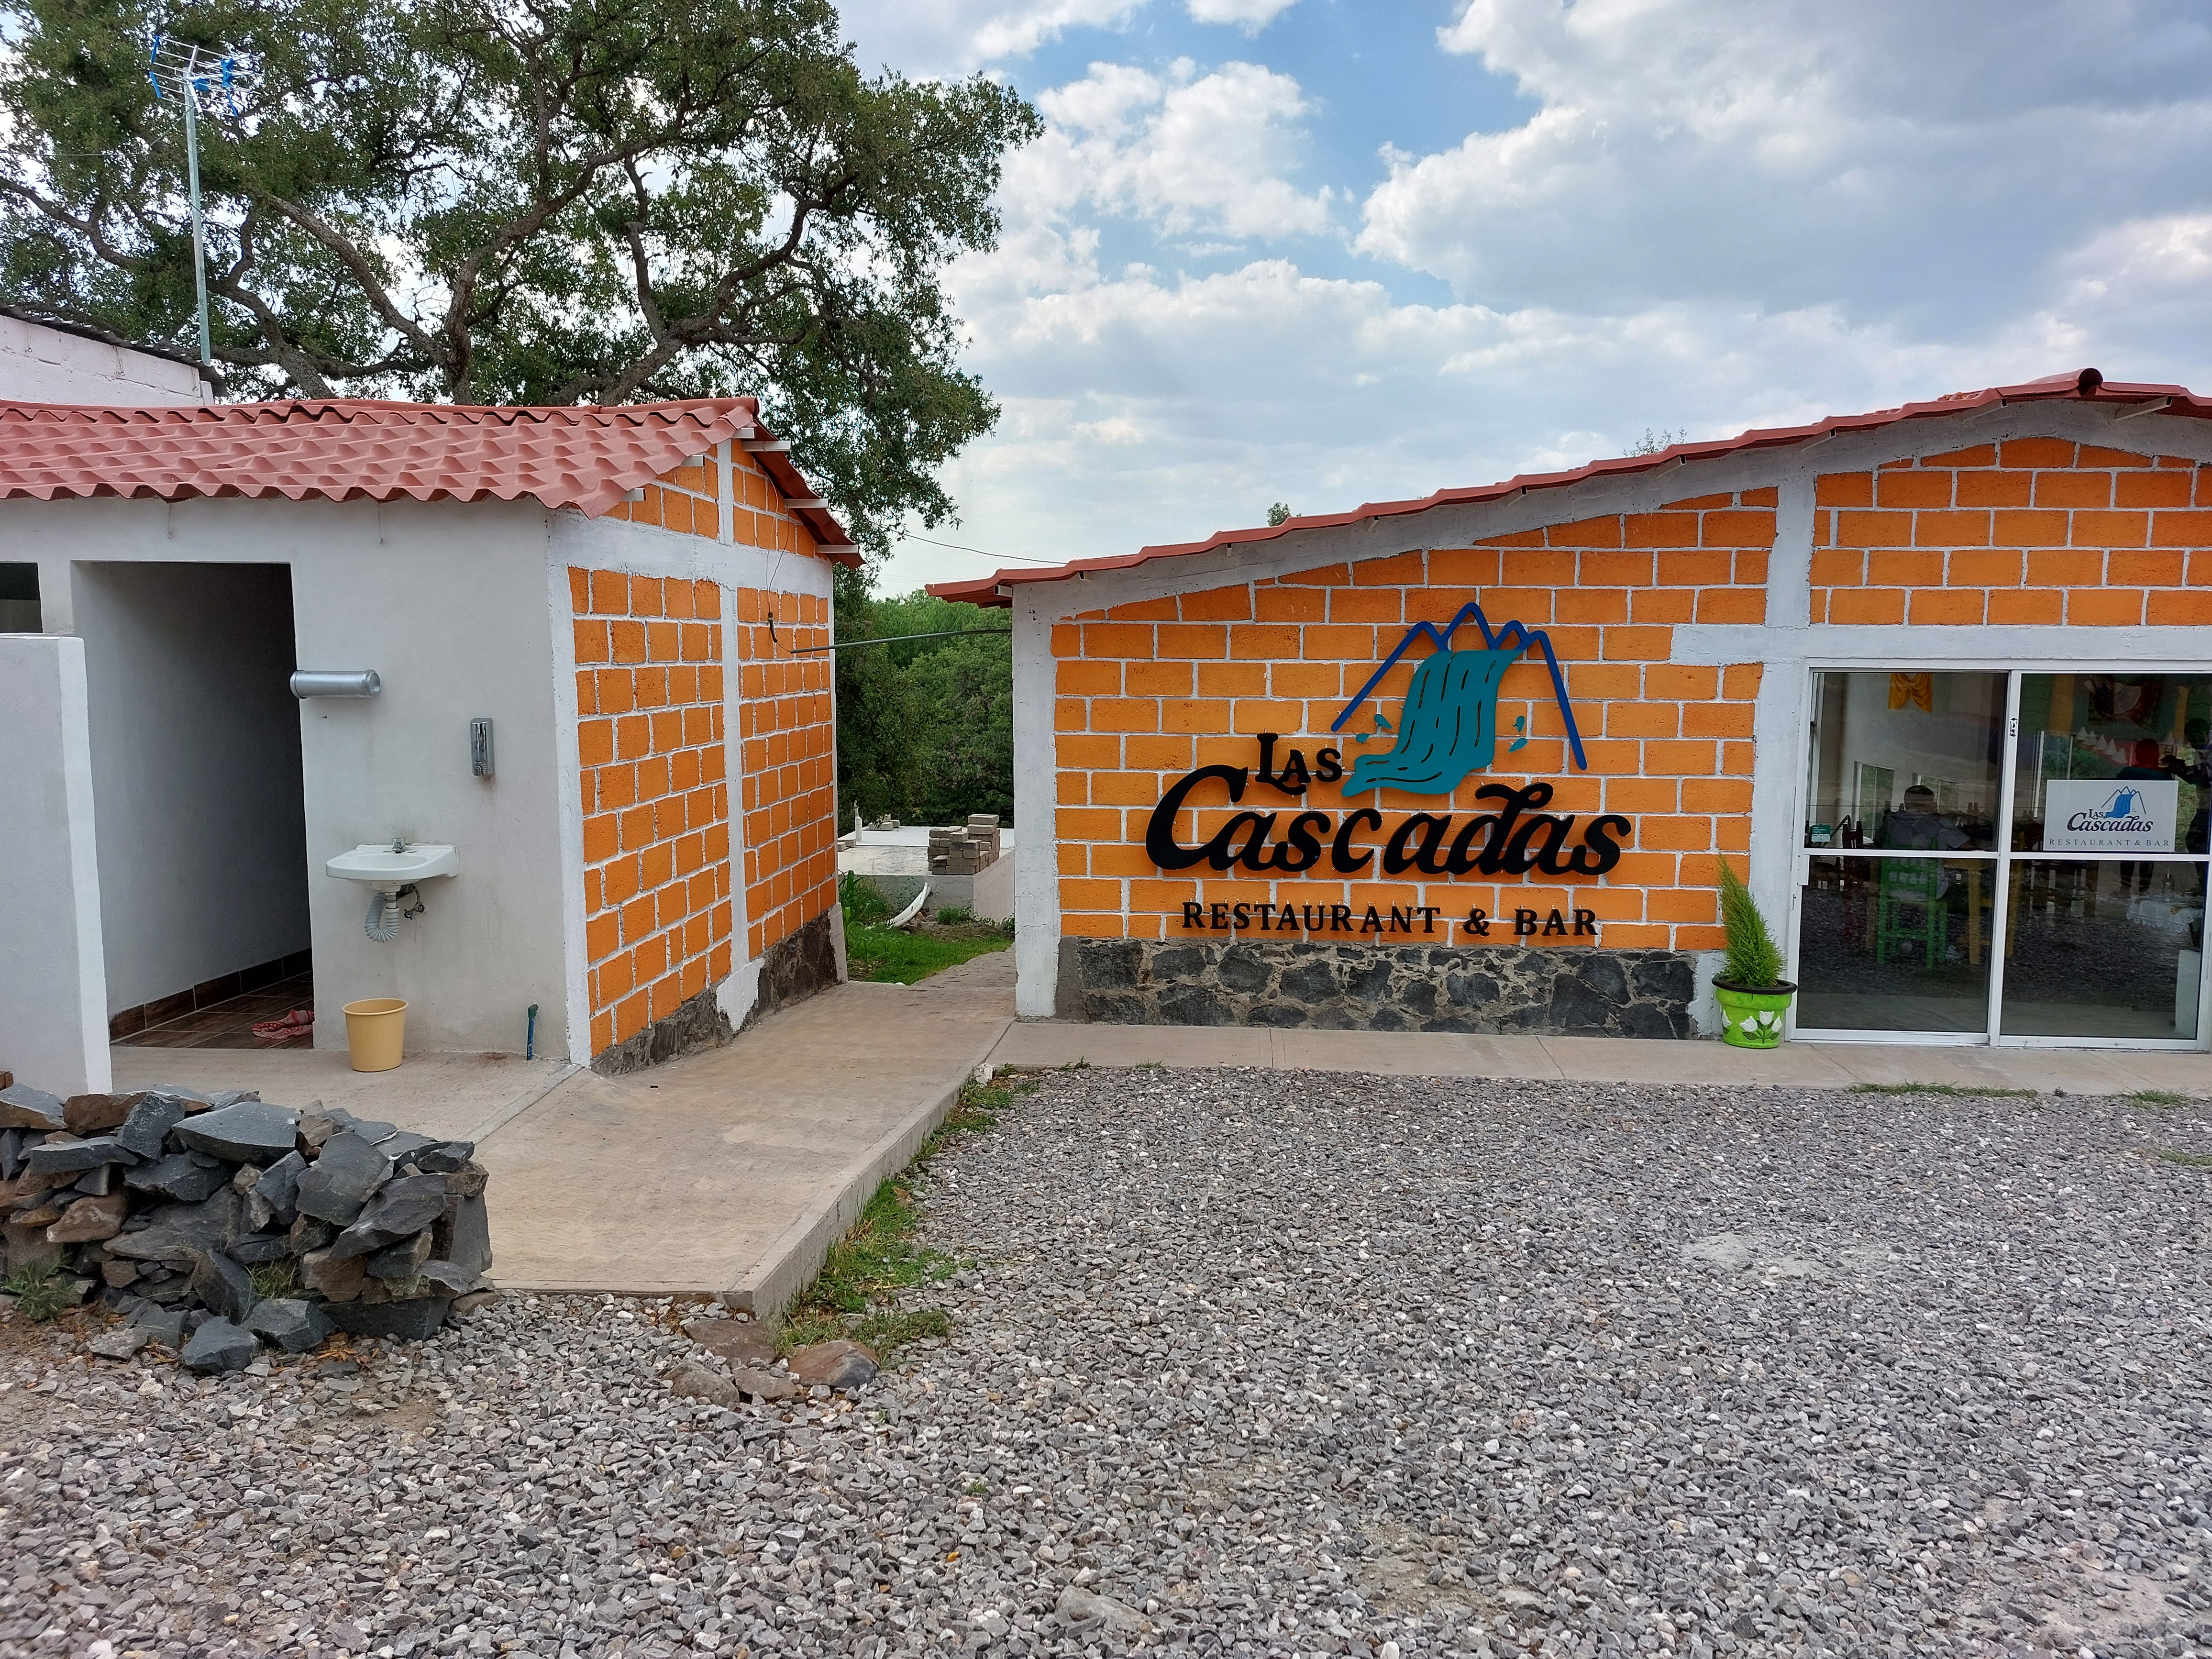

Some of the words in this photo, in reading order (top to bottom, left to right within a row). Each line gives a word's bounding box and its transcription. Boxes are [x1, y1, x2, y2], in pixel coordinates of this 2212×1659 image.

[1255, 733, 1343, 796] LAS
[1145, 764, 1632, 876] Cascadas
[2067, 812, 2154, 832] Cascadas
[2088, 808, 2104, 819] LAS
[1182, 901, 1441, 934] RESTAURANT
[1462, 908, 1490, 937] &
[1513, 907, 1599, 936] BAR
